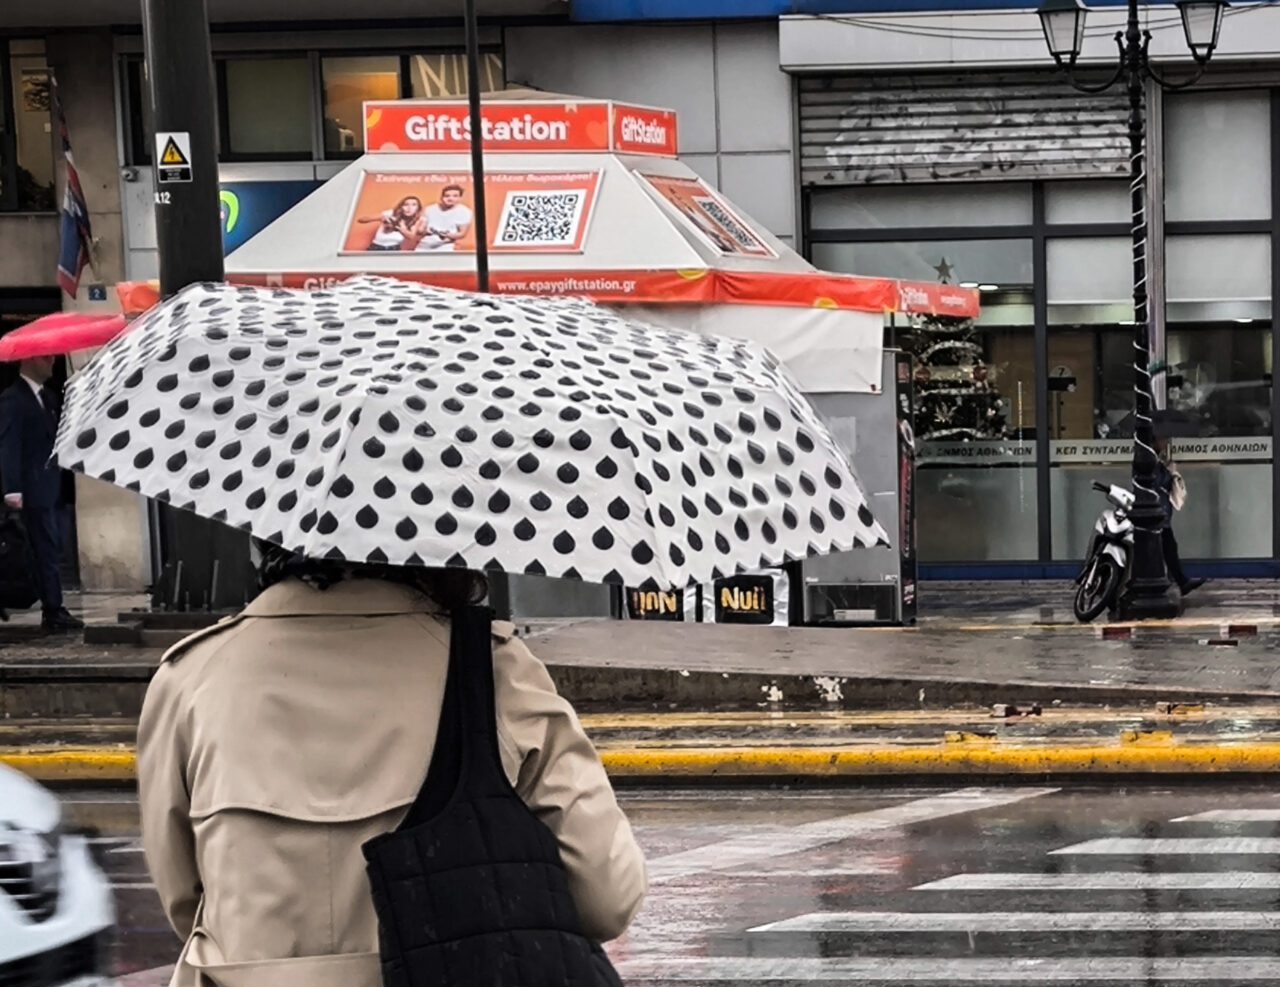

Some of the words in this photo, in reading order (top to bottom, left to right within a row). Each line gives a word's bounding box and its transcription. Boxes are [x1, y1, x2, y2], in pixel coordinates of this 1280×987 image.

[405, 114, 567, 141] GiftStation
[621, 115, 666, 145] GiftStation
[497, 278, 636, 293] www.epaygiftstation.gr
[976, 446, 1033, 456] ΑΘΗΙΩΝ
[1056, 446, 1077, 455] ΚΕΠ
[1211, 443, 1268, 453] ΑΘΗΝΑΙΩΝ
[721, 585, 765, 610] Nuii
